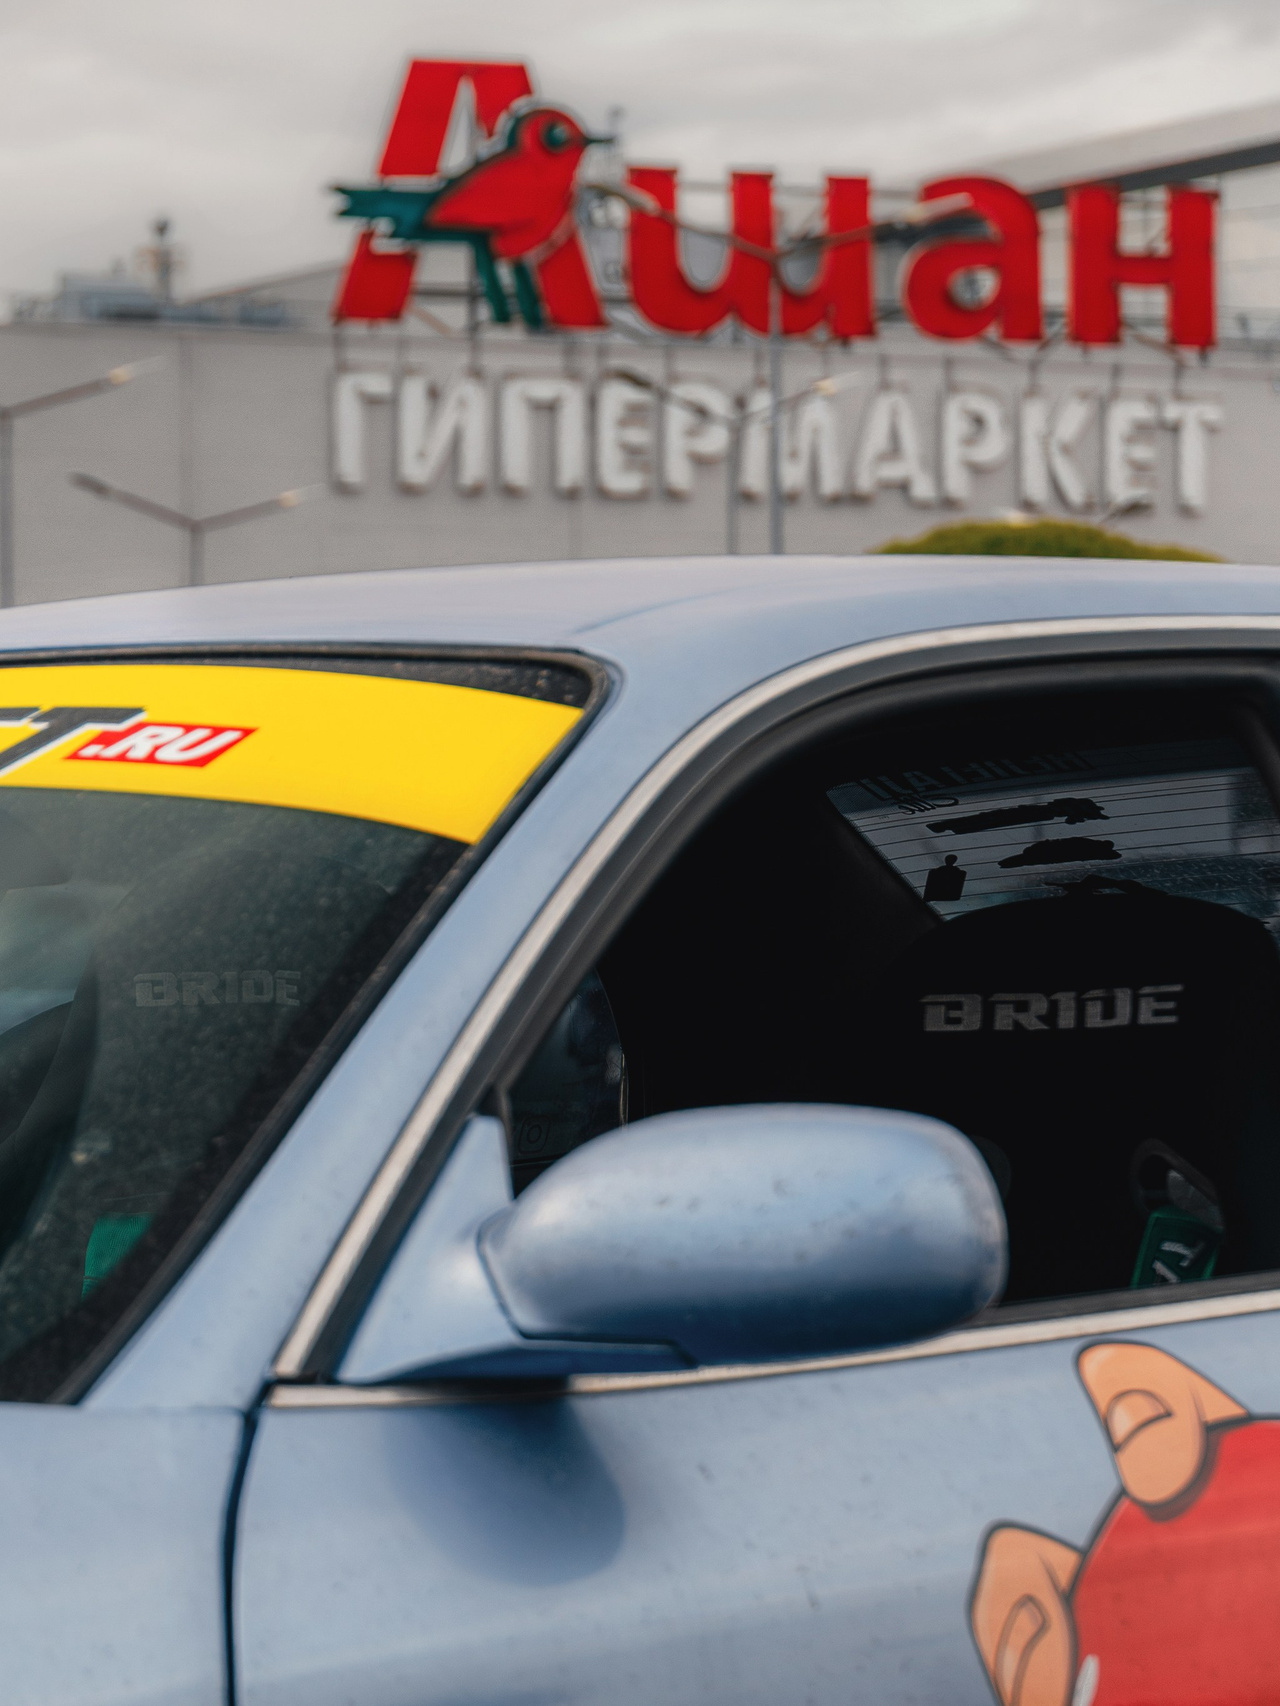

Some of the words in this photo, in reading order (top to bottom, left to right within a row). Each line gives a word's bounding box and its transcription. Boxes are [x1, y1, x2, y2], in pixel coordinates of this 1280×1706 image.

[331, 367, 1224, 514] ГИПЕРМАРКЕТ
[133, 970, 301, 1007] BRIDE
[921, 984, 1184, 1032] BRIDE
